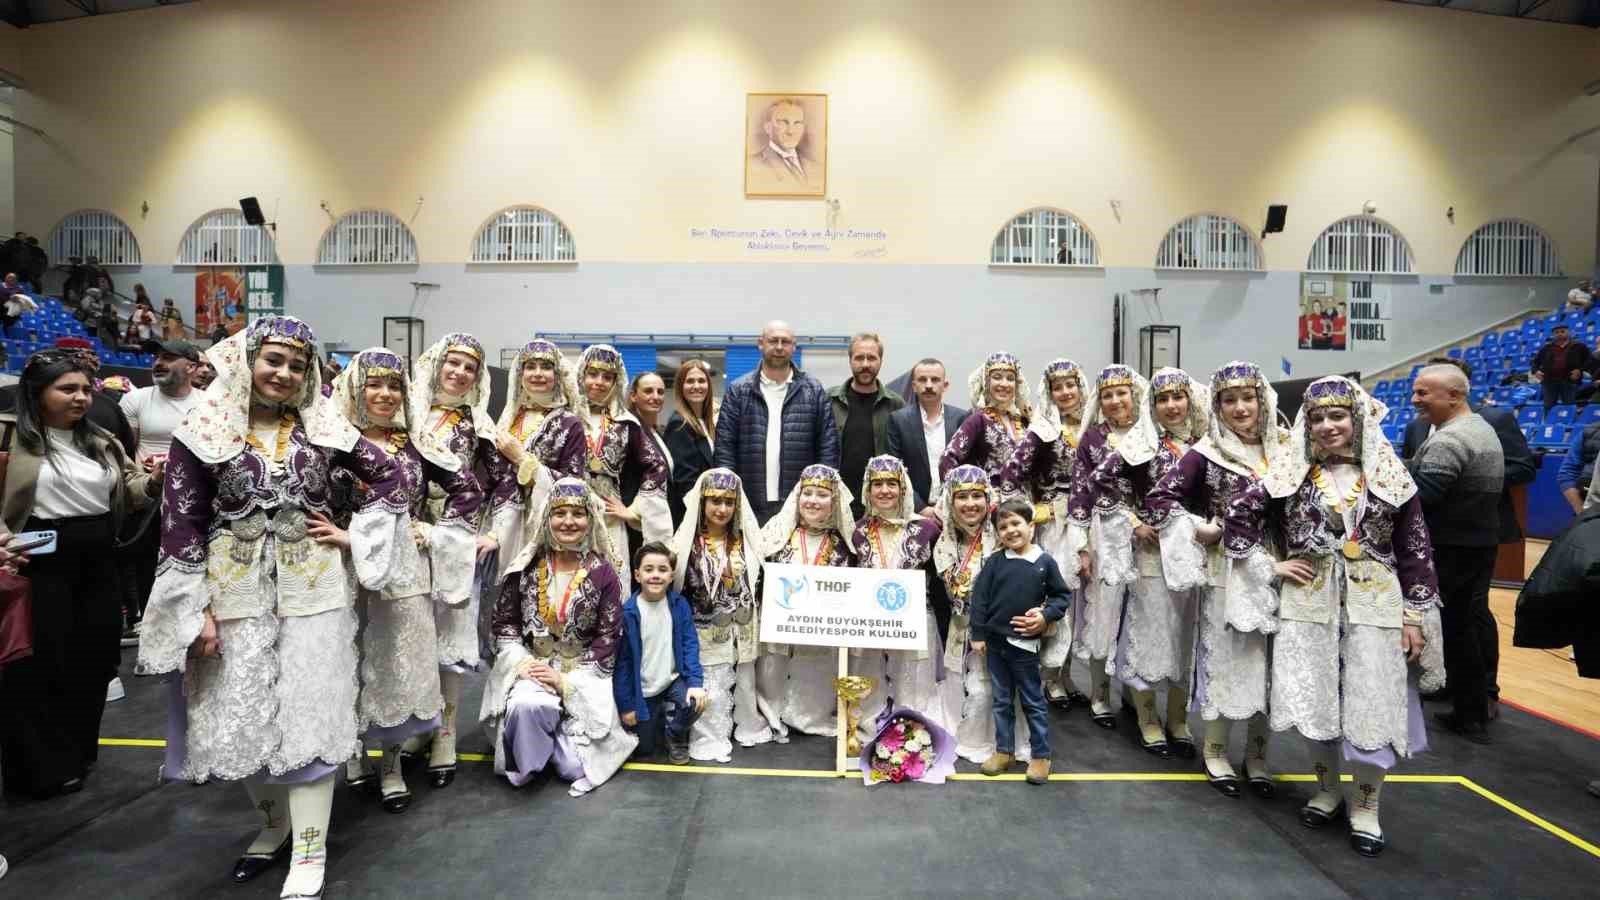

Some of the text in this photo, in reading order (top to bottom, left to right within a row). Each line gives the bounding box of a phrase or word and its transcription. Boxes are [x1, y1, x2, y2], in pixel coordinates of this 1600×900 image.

[815, 580, 852, 593] THOF
[787, 614, 904, 628] AYDIN BÜYÜKŞEHİR
[776, 624, 918, 639] BELEDİYESPOR KULÜBÜ
